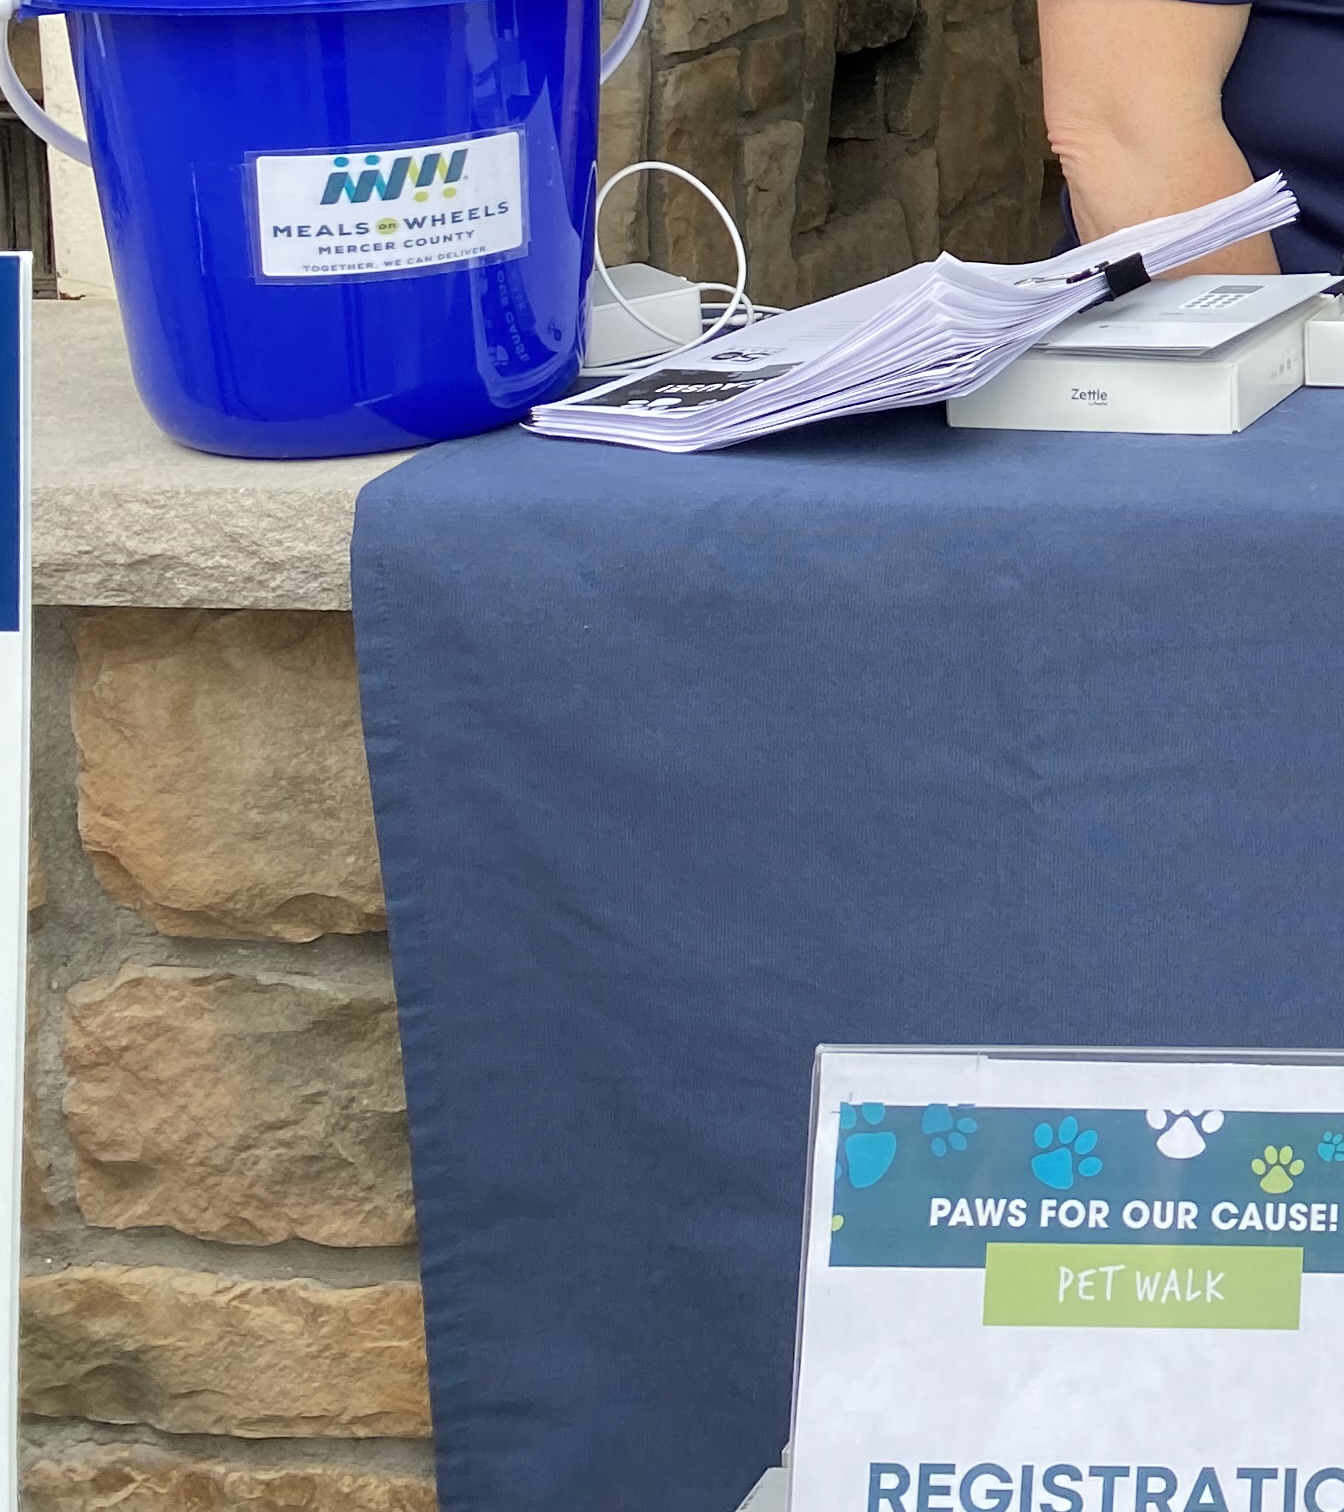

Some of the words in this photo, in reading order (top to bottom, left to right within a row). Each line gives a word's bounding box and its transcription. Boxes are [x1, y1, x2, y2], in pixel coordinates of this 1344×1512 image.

[272, 222, 370, 239] MEALS
[403, 200, 510, 232] WHEELS
[317, 240, 397, 256] MERCER
[403, 228, 476, 249] COUNTY
[383, 258, 403, 268] WE
[406, 254, 433, 265] CAN
[1070, 387, 1108, 401] Zettle
[928, 1196, 1028, 1229] PAWS
[1039, 1199, 1111, 1231] FOR
[1122, 1199, 1198, 1231] OUR
[1210, 1201, 1339, 1234] CAUSE!
[1056, 1263, 1126, 1303] PET
[1133, 1270, 1226, 1304] WALK
